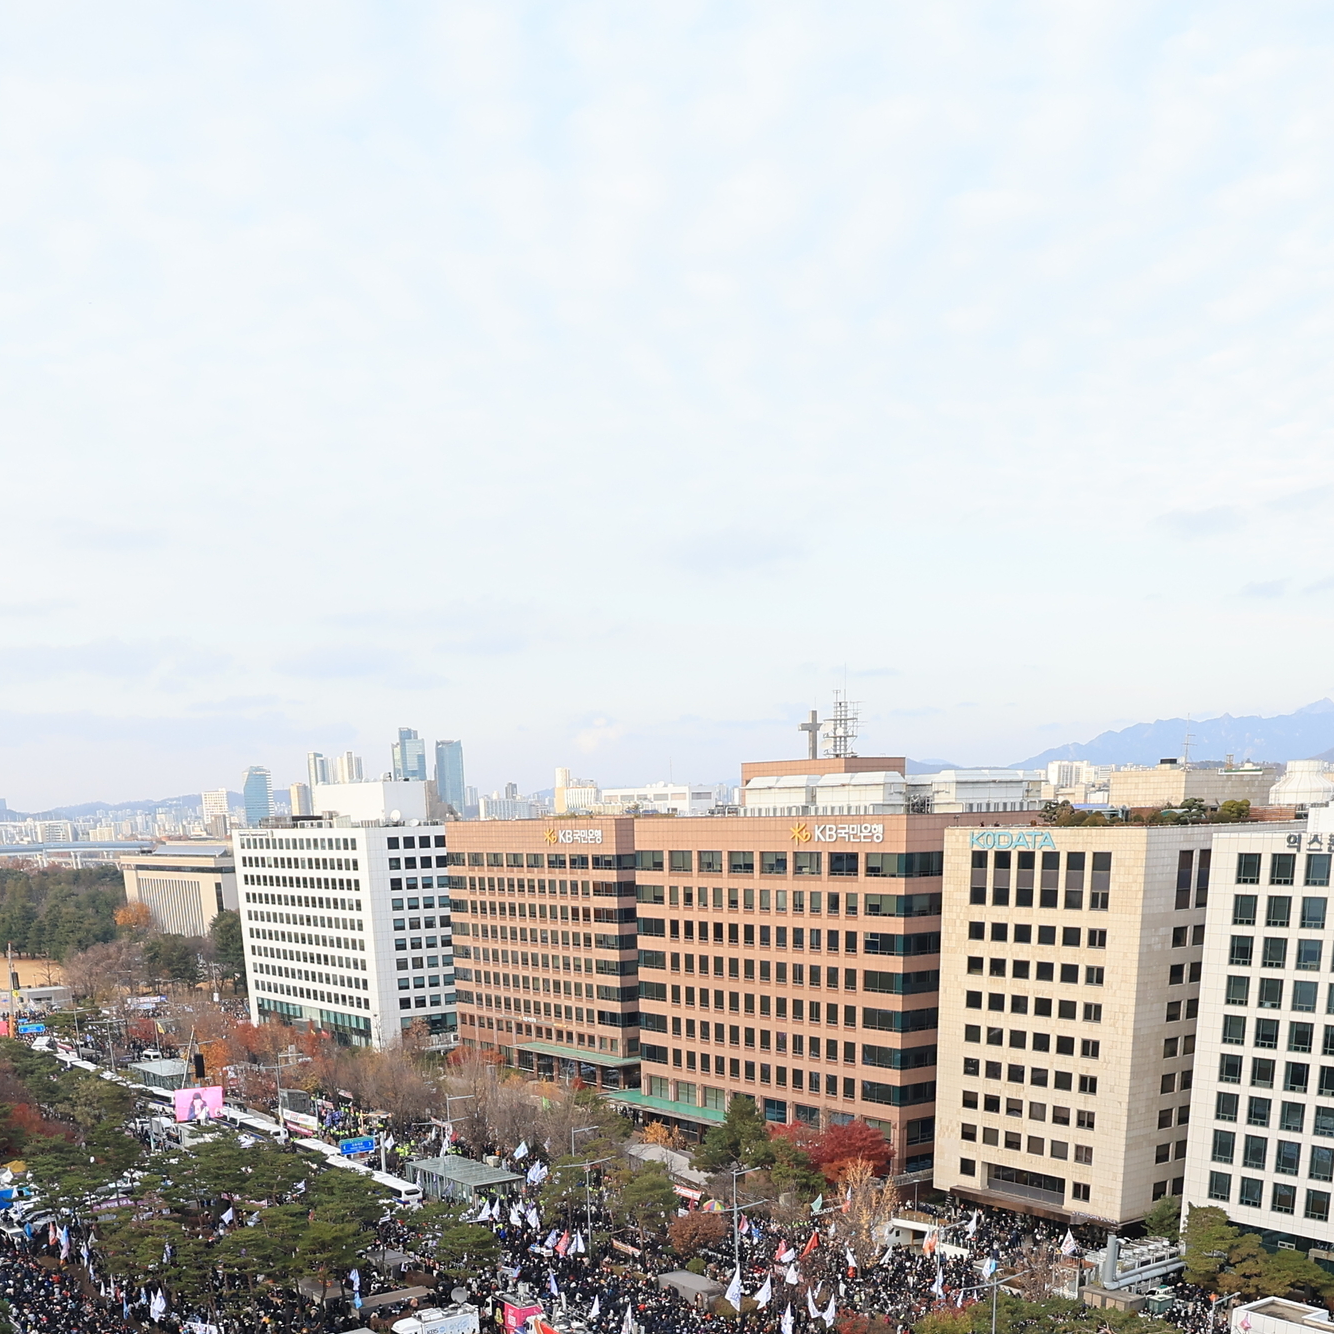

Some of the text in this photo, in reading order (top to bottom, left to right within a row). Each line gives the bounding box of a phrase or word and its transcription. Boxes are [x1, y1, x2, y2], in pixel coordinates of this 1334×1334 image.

[558, 828, 603, 845] KB국민은행
[814, 823, 884, 844] KB국민은행
[969, 831, 1056, 851] KODATA
